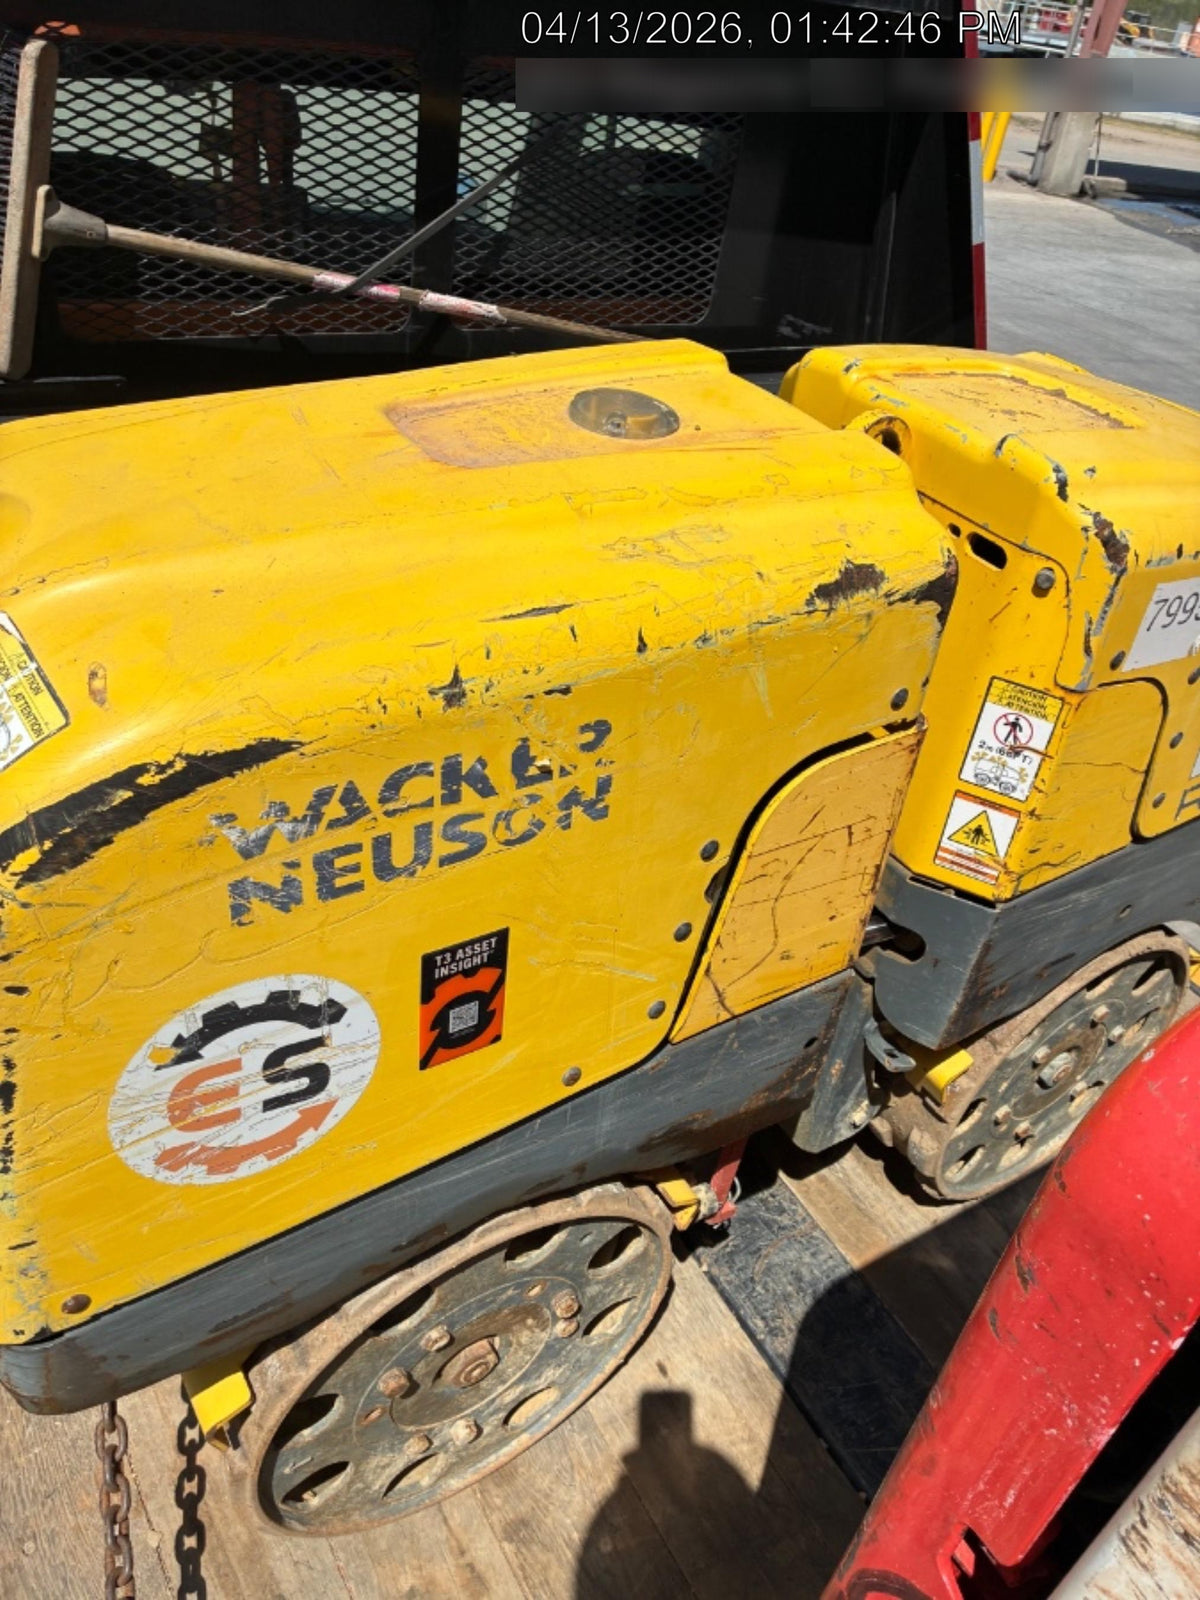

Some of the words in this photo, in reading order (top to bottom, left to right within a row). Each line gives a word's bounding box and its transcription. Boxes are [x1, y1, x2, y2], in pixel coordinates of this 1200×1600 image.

[17, 660, 44, 696] CTION
[228, 774, 612, 927] NEUSON
[434, 950, 490, 979] INSIGHT
[435, 952, 452, 967] T3
[456, 936, 498, 961] ASSET
